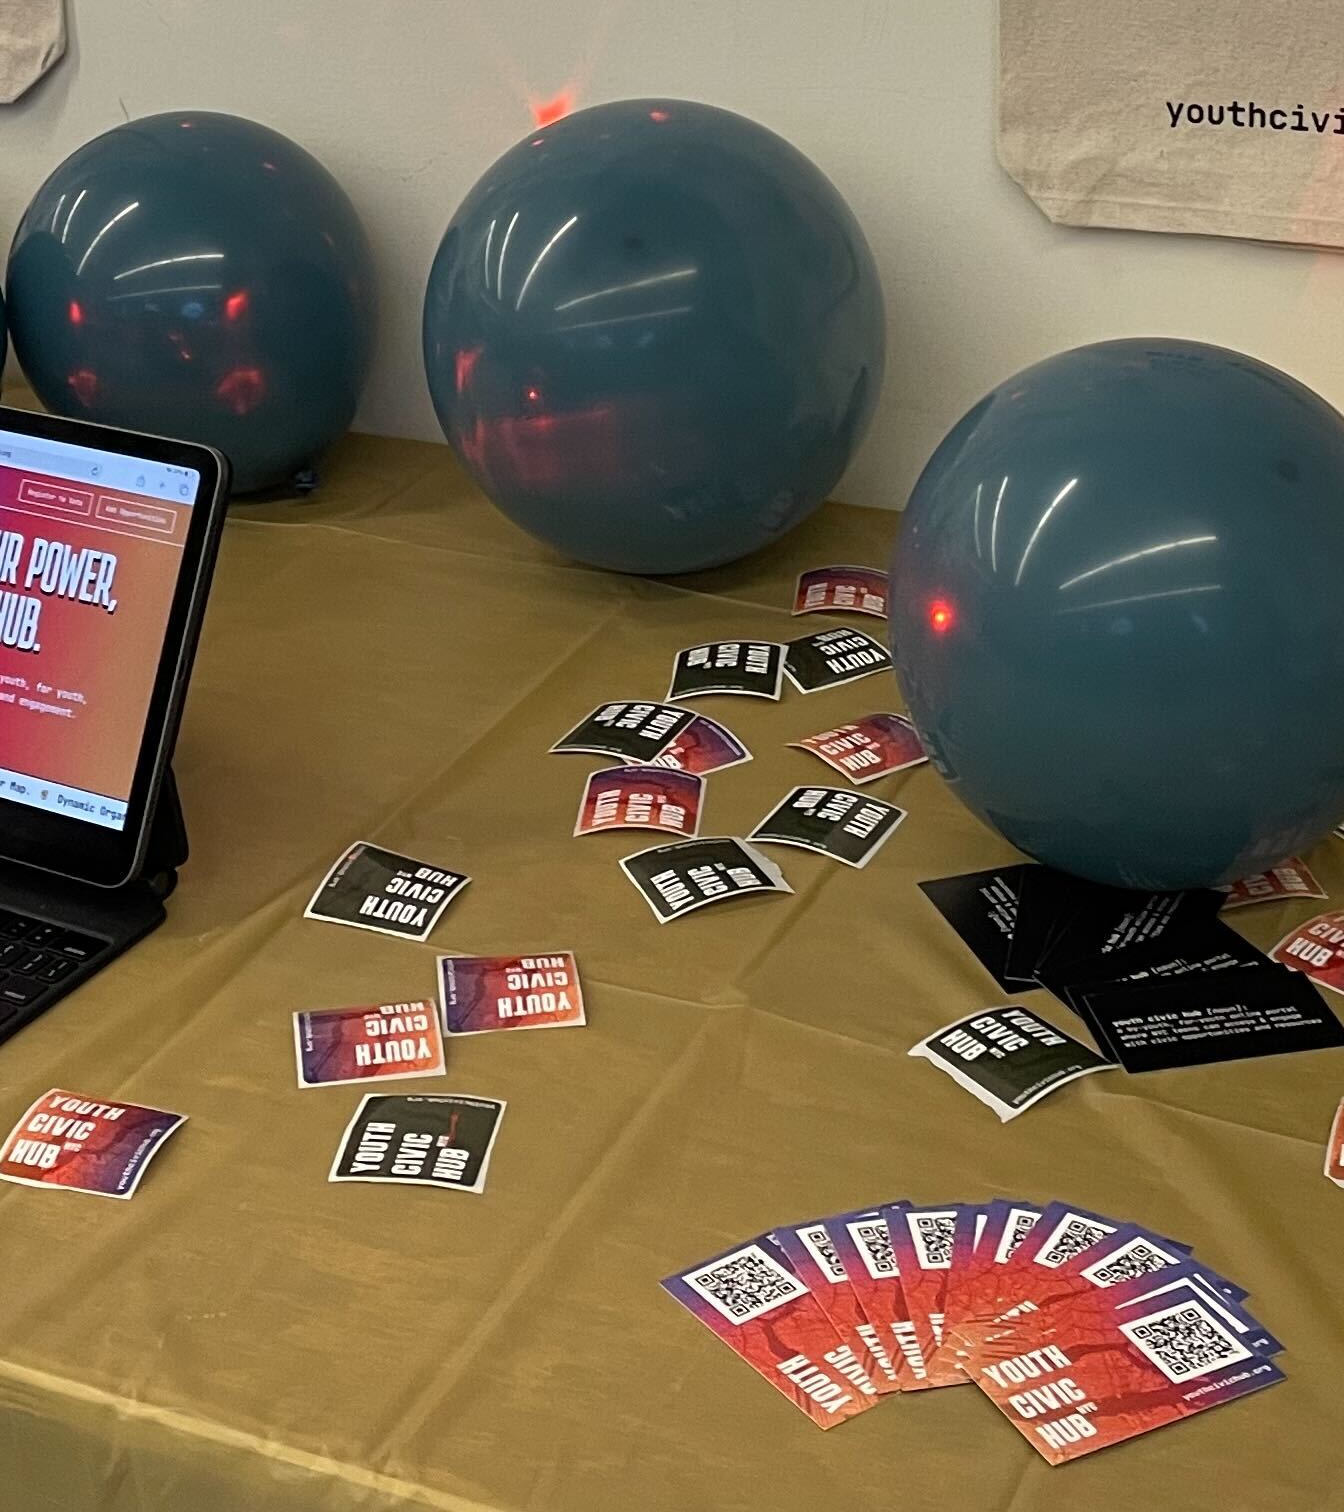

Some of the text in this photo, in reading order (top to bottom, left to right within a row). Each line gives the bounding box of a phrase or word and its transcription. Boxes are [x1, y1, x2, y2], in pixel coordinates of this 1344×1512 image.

[24, 537, 118, 613] POWER,
[826, 647, 886, 674] YOUTH
[817, 793, 859, 822] CIVIC
[843, 803, 890, 839] YOUTH
[385, 877, 445, 904] CIVIC
[414, 867, 459, 887] HUB
[650, 869, 695, 911] YOUTH
[687, 865, 729, 896] CIVIC
[359, 895, 429, 927] YOUTH
[521, 957, 565, 970] HUB
[1286, 937, 1337, 968] HUB
[507, 971, 569, 990] CIVIC
[497, 991, 573, 1019] YOUTH
[364, 1014, 428, 1038] CIVIC
[969, 1016, 1030, 1052] CIVIC
[1001, 1009, 1068, 1047] YOUTH
[355, 1037, 434, 1068] YOUTH
[939, 1028, 988, 1062] HUB
[47, 1094, 125, 1123] YOUTH
[27, 1113, 96, 1141] CIVIC
[8, 1139, 62, 1170] HUB
[350, 1121, 396, 1176] YOUTH
[390, 1132, 435, 1176] CIVIC
[432, 1147, 470, 1181] HUB
[981, 1344, 1073, 1389] YOUTH
[776, 1354, 854, 1415] YOUTH
[1007, 1377, 1088, 1420] CIVIC
[1035, 1413, 1098, 1450] HUB
